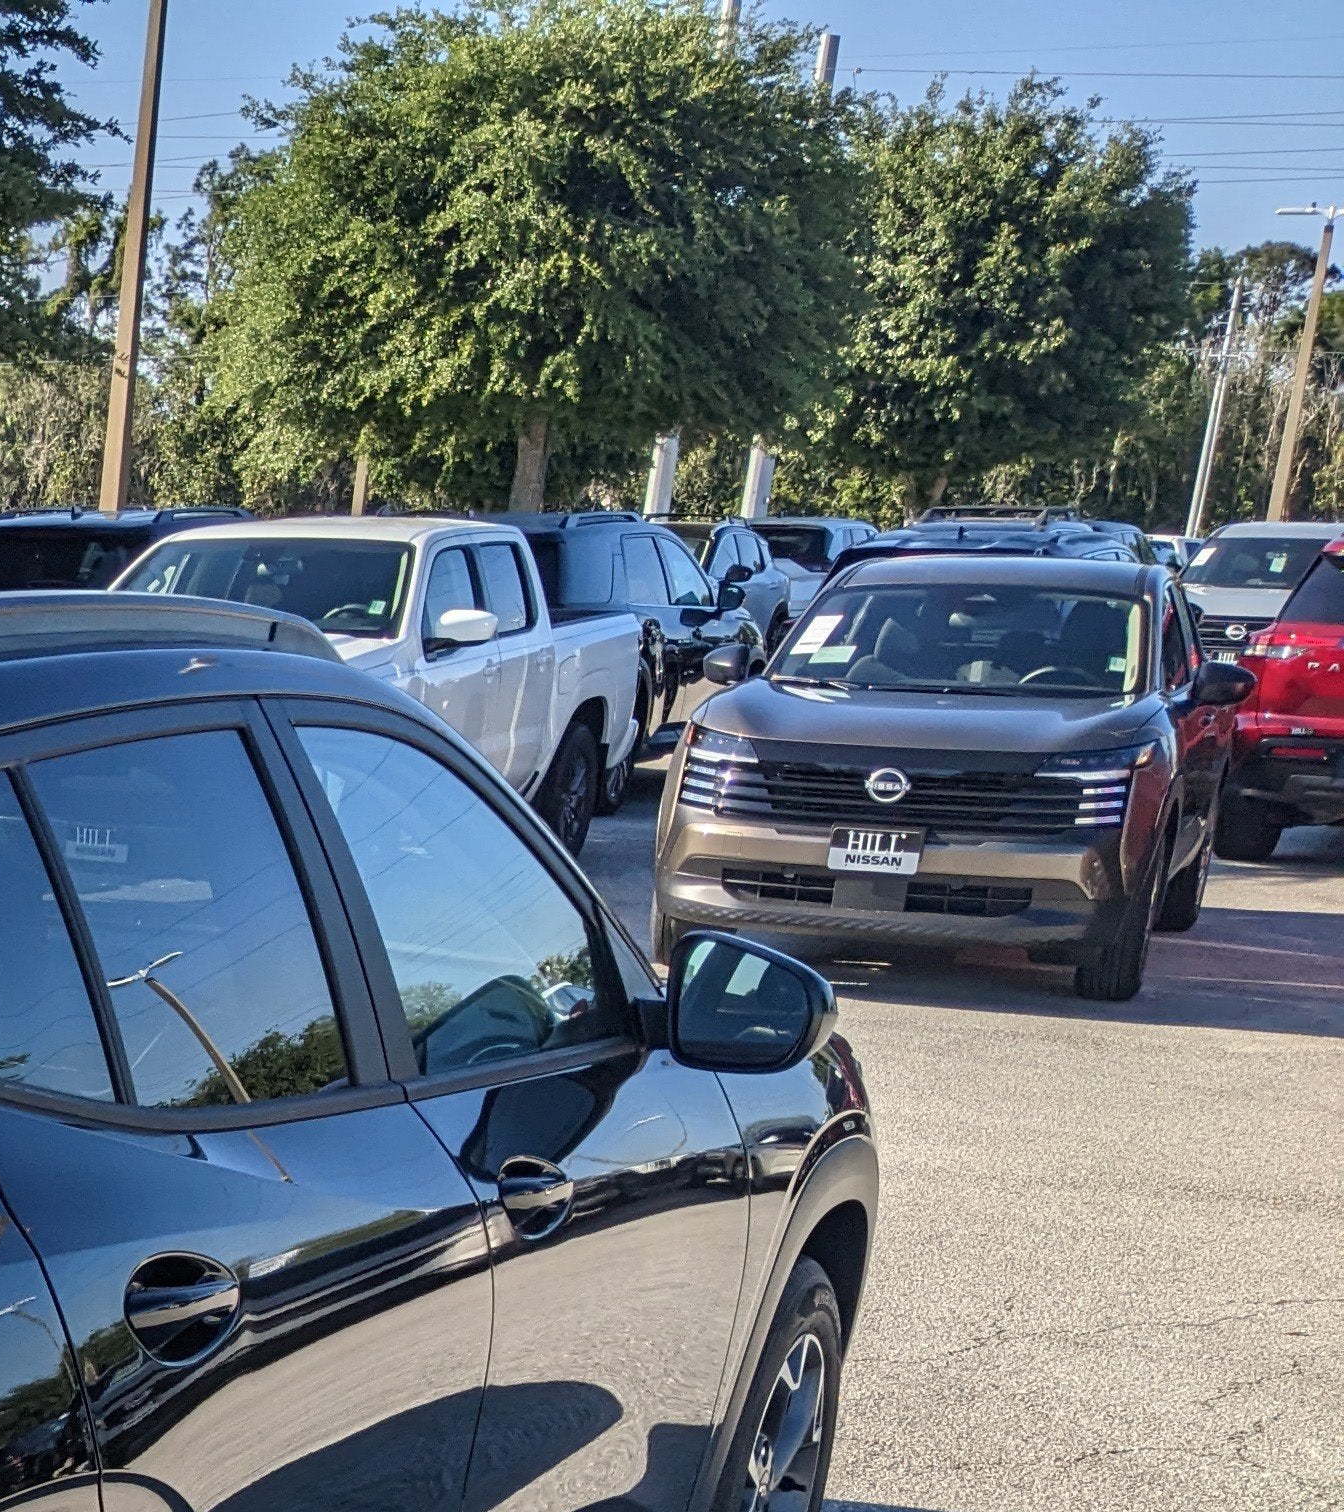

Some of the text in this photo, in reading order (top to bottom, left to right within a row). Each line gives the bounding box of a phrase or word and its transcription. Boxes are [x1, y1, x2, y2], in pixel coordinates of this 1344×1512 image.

[864, 779, 911, 791] NISSAN
[847, 830, 904, 855] HILL
[844, 854, 903, 867] NISSAN
